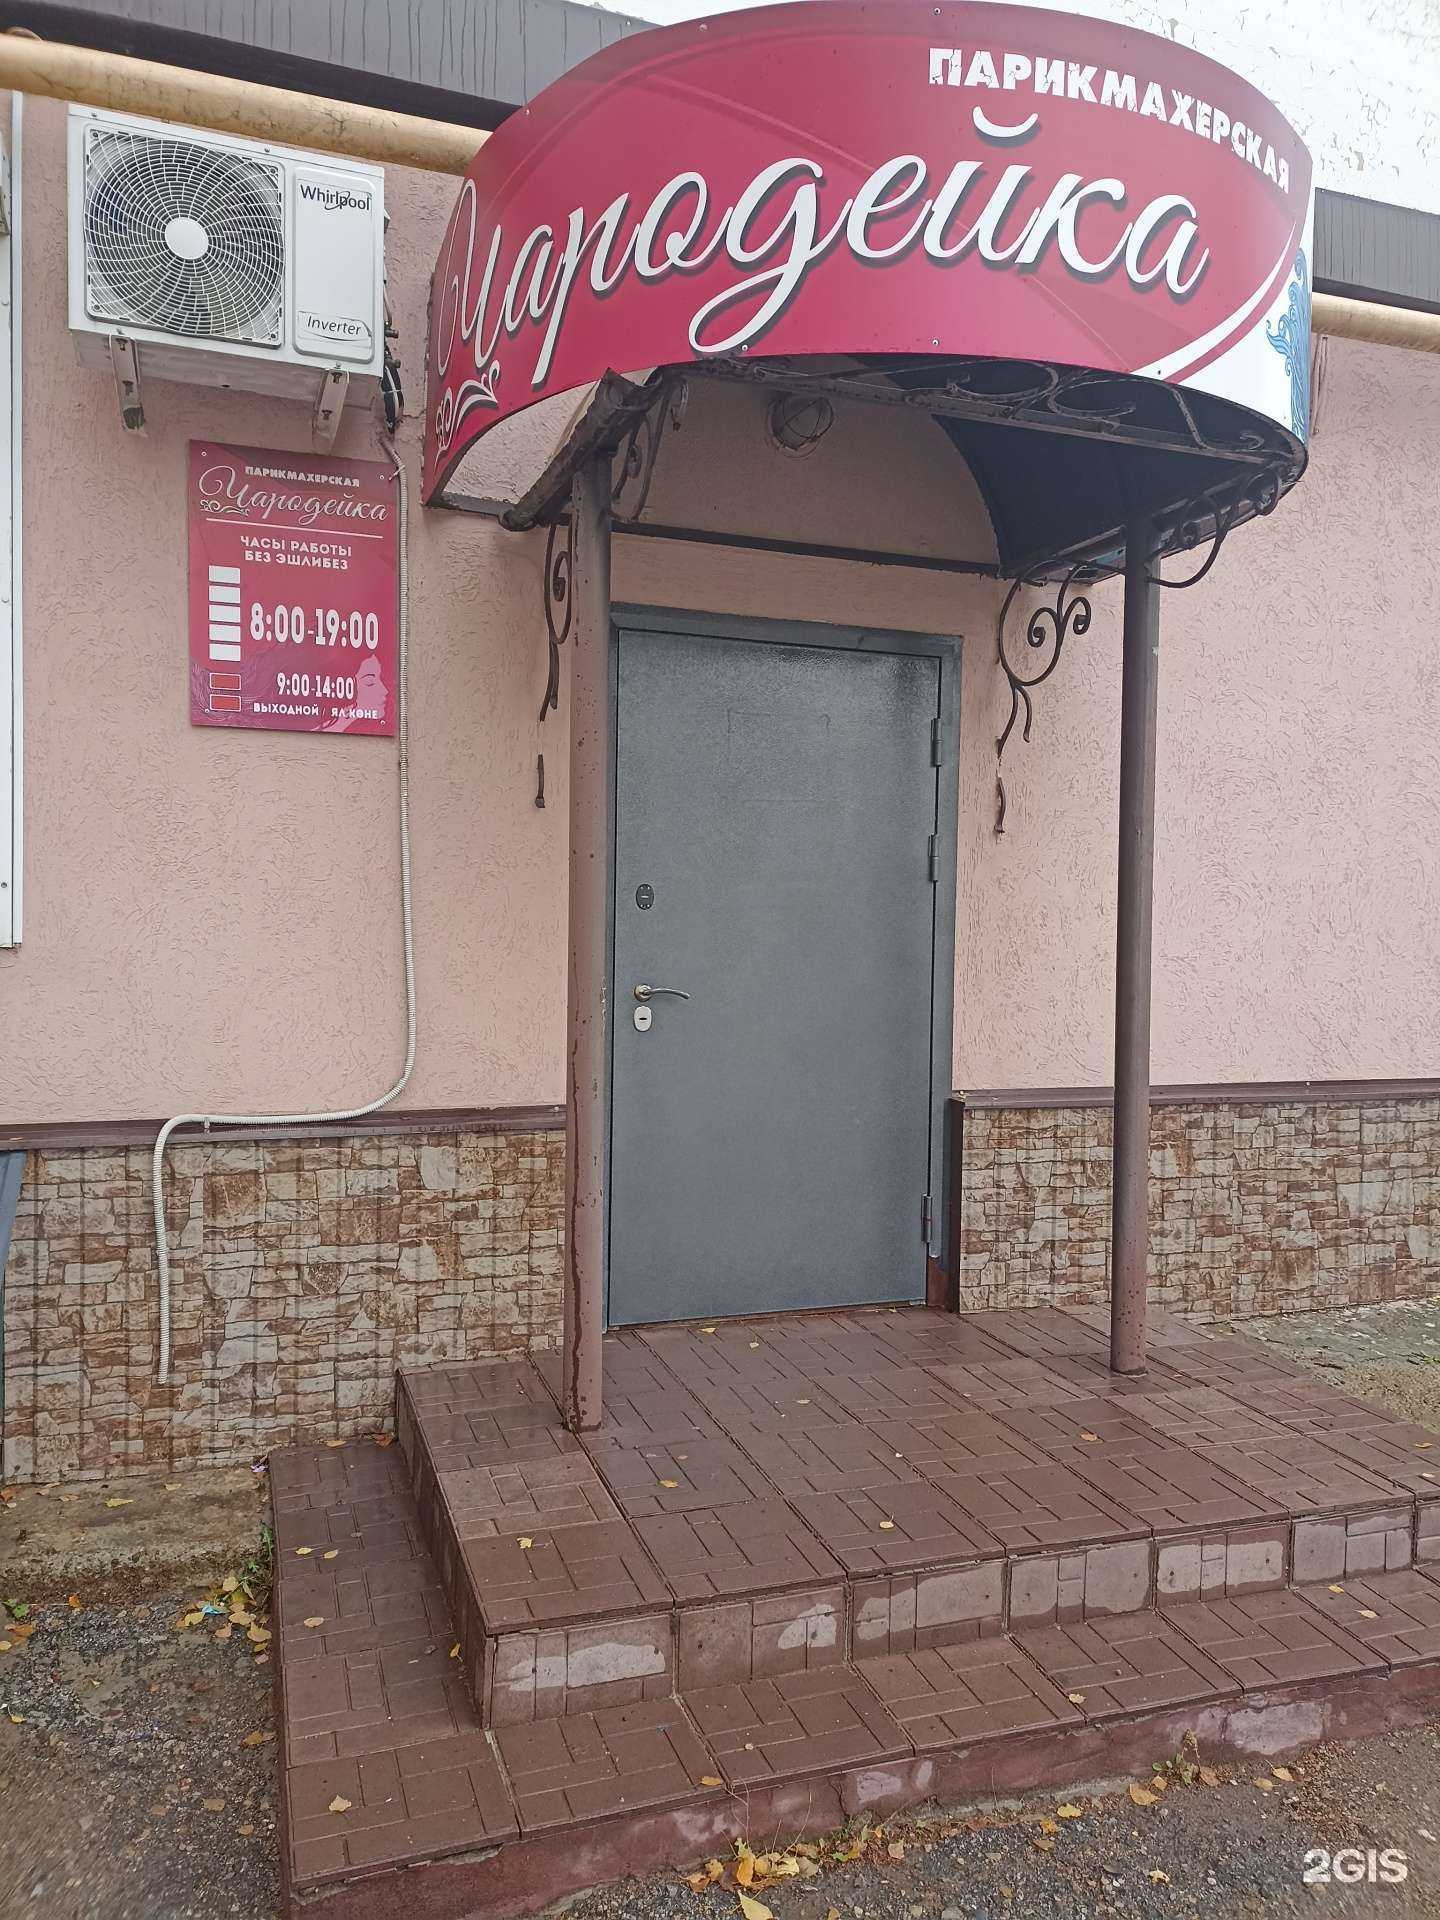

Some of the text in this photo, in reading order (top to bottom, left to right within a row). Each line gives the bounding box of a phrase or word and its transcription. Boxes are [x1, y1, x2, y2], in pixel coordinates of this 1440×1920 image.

[928, 46, 1291, 191] ПАРИКМАХЕРСКАЯ
[299, 184, 371, 211] Whirlpool
[437, 106, 1210, 385] Чародейка
[307, 315, 361, 336] Inverter
[245, 465, 360, 487] ПАРИКМАХЕРСКАЯ
[199, 465, 388, 526] Чародейка
[240, 535, 352, 557] ЧАСЫ РАБОТЫ
[244, 550, 348, 570] БЕЗ ЭШЛИБЕЗ
[250, 602, 379, 650] 8:00-19:00
[253, 702, 319, 716] ВЫХОДНОЙ
